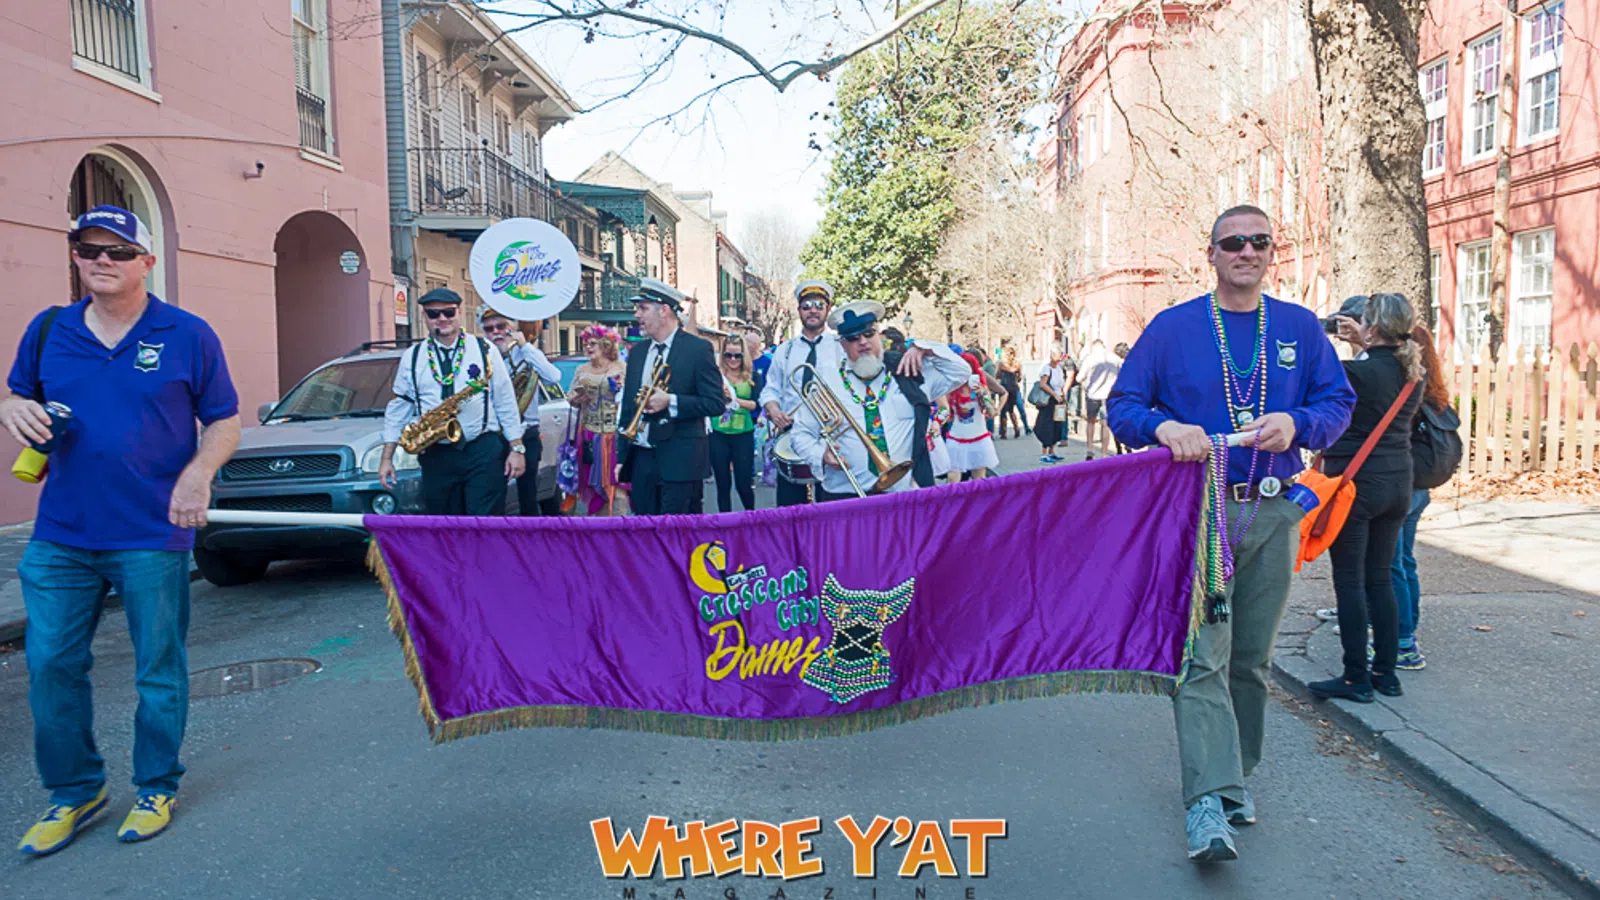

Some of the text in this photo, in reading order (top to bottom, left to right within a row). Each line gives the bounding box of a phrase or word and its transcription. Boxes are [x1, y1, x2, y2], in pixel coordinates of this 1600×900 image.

[700, 566, 807, 621] Crescent
[777, 596, 819, 630] City
[706, 620, 821, 680] Dames
